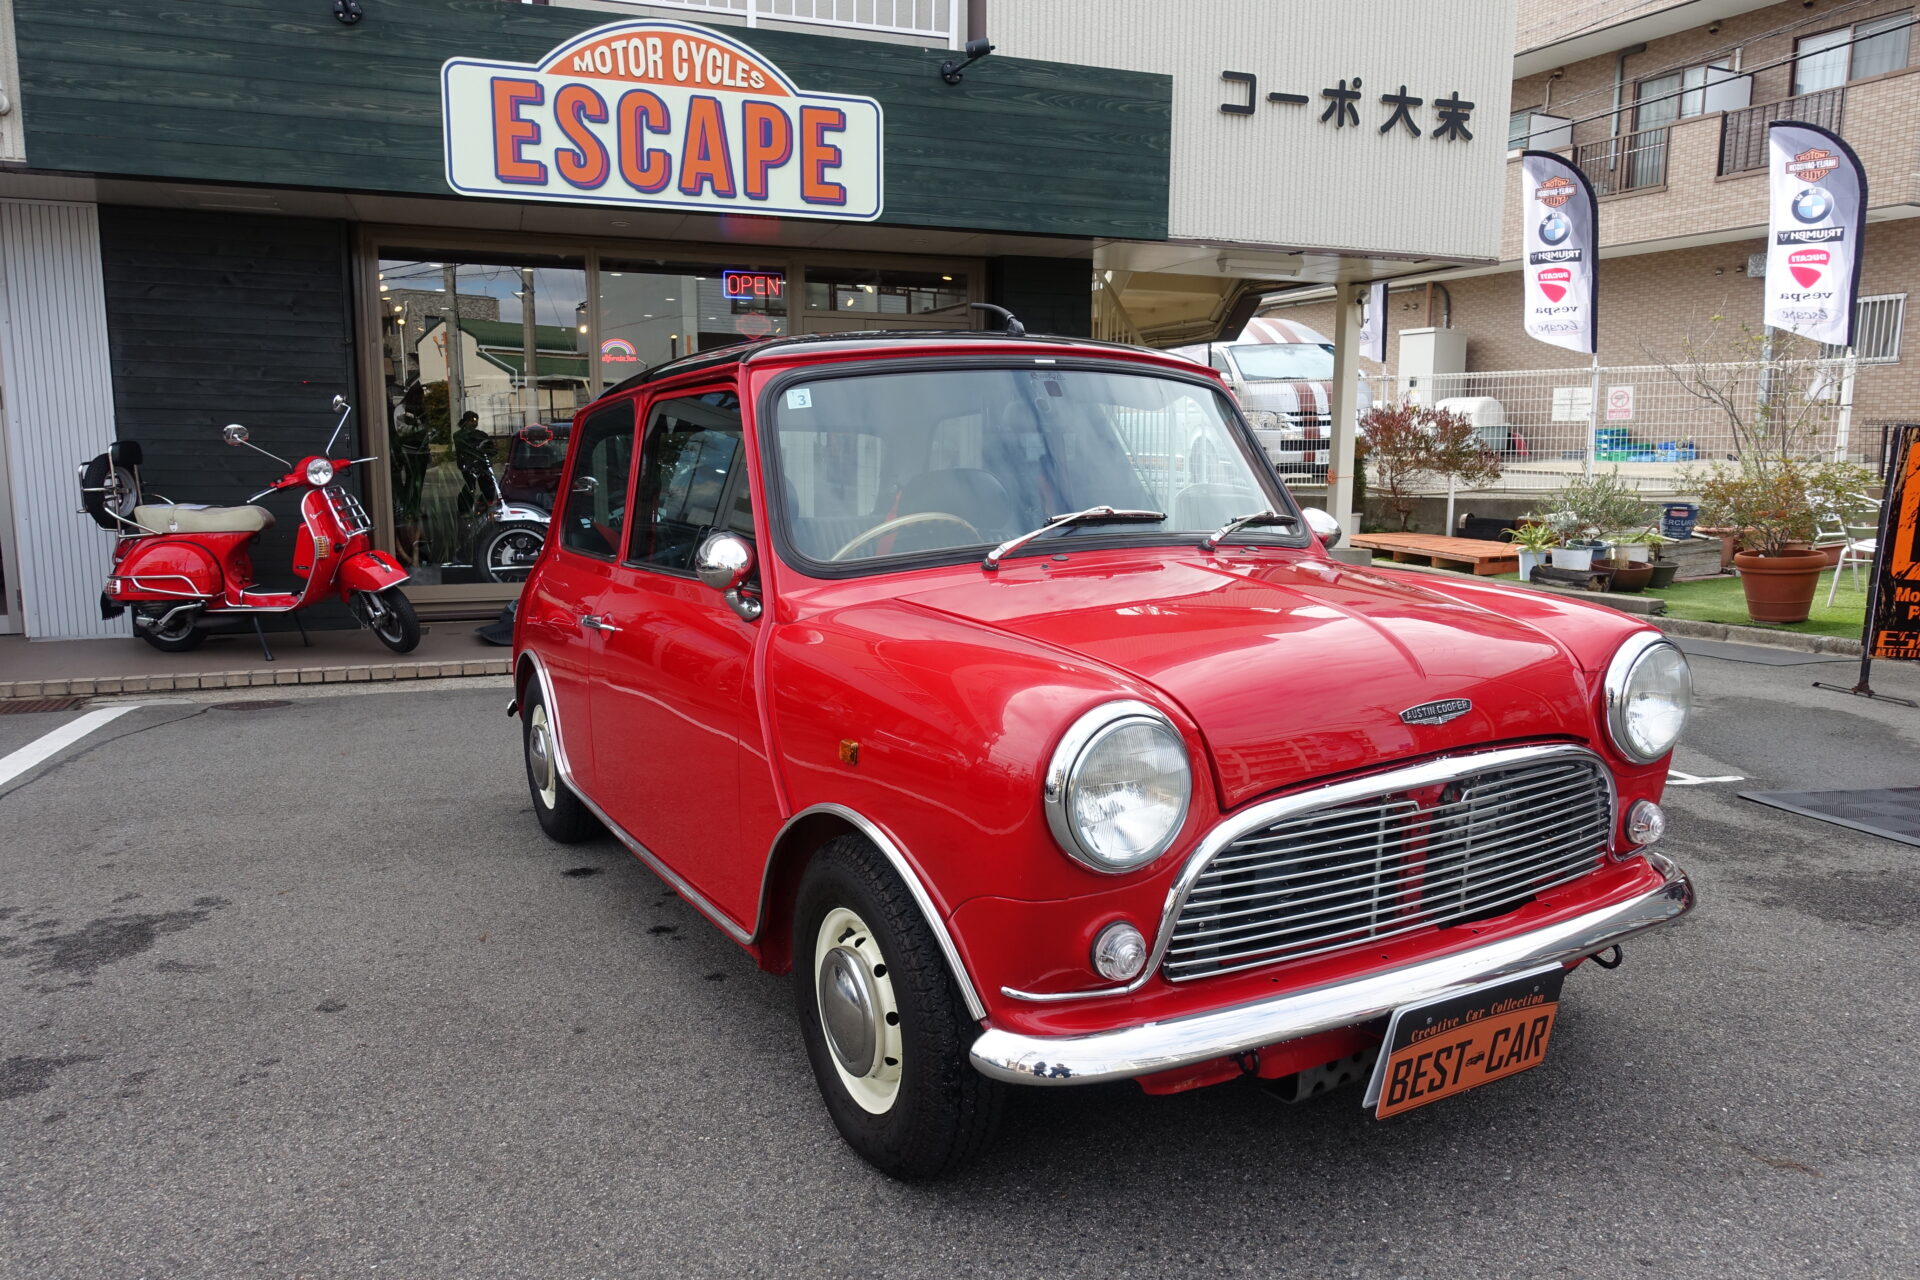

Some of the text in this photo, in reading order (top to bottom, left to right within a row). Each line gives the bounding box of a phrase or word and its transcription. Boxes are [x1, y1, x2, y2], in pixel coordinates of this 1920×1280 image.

[572, 36, 766, 90] MOTOR CYCLES
[1220, 70, 1476, 141] コーポ大末
[490, 76, 847, 205] ESCAPE
[727, 275, 779, 295] OPEN
[797, 394, 807, 406] 3
[1406, 700, 1468, 720] AUSTIN COOPER
[1410, 994, 1545, 1043] Creative Car Collection
